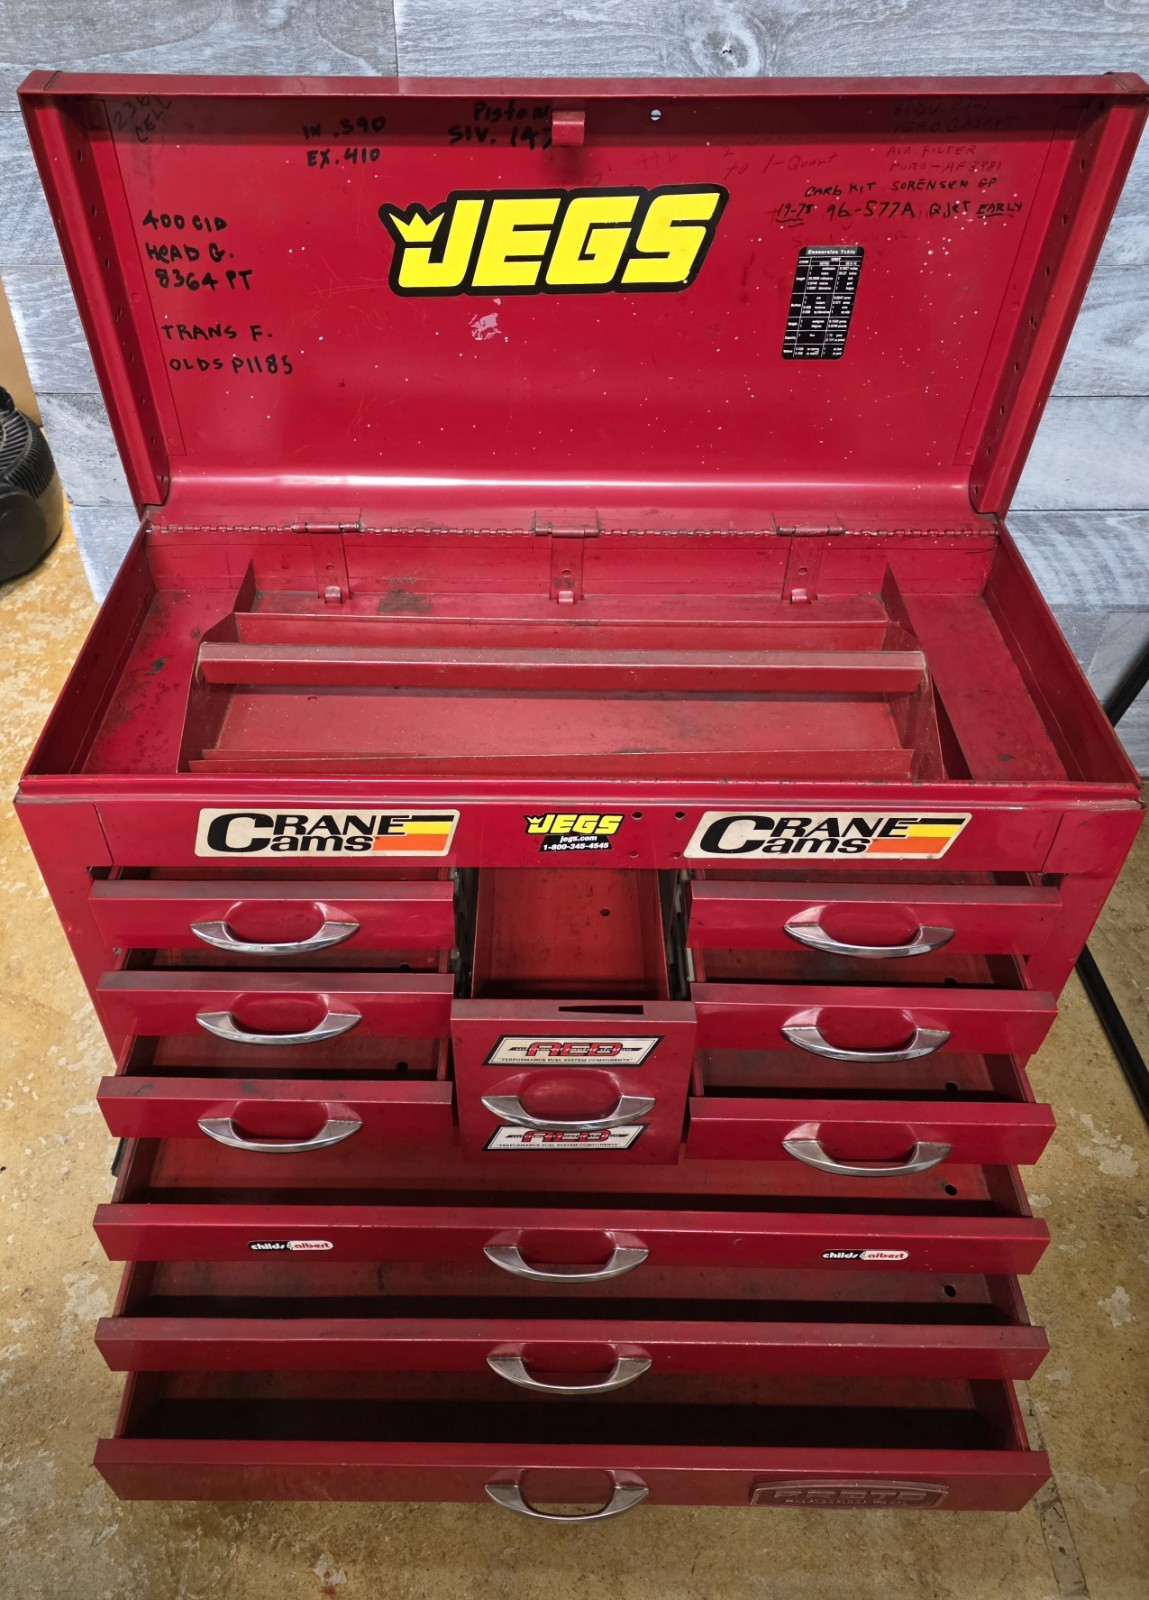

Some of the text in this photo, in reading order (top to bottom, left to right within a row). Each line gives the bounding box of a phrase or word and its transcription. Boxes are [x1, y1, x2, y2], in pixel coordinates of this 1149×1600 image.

[142, 209, 186, 231] 400
[394, 192, 722, 289] JEGS
[154, 268, 253, 291] 8364 PT
[161, 323, 238, 341] TRANS
[169, 357, 224, 372] OLDS
[207, 813, 410, 852] CRANE
[526, 813, 624, 835] JEGS
[700, 815, 919, 854] CRANE
[543, 841, 609, 851] 1-800-345-4545
[560, 836, 598, 844] jegs.com
